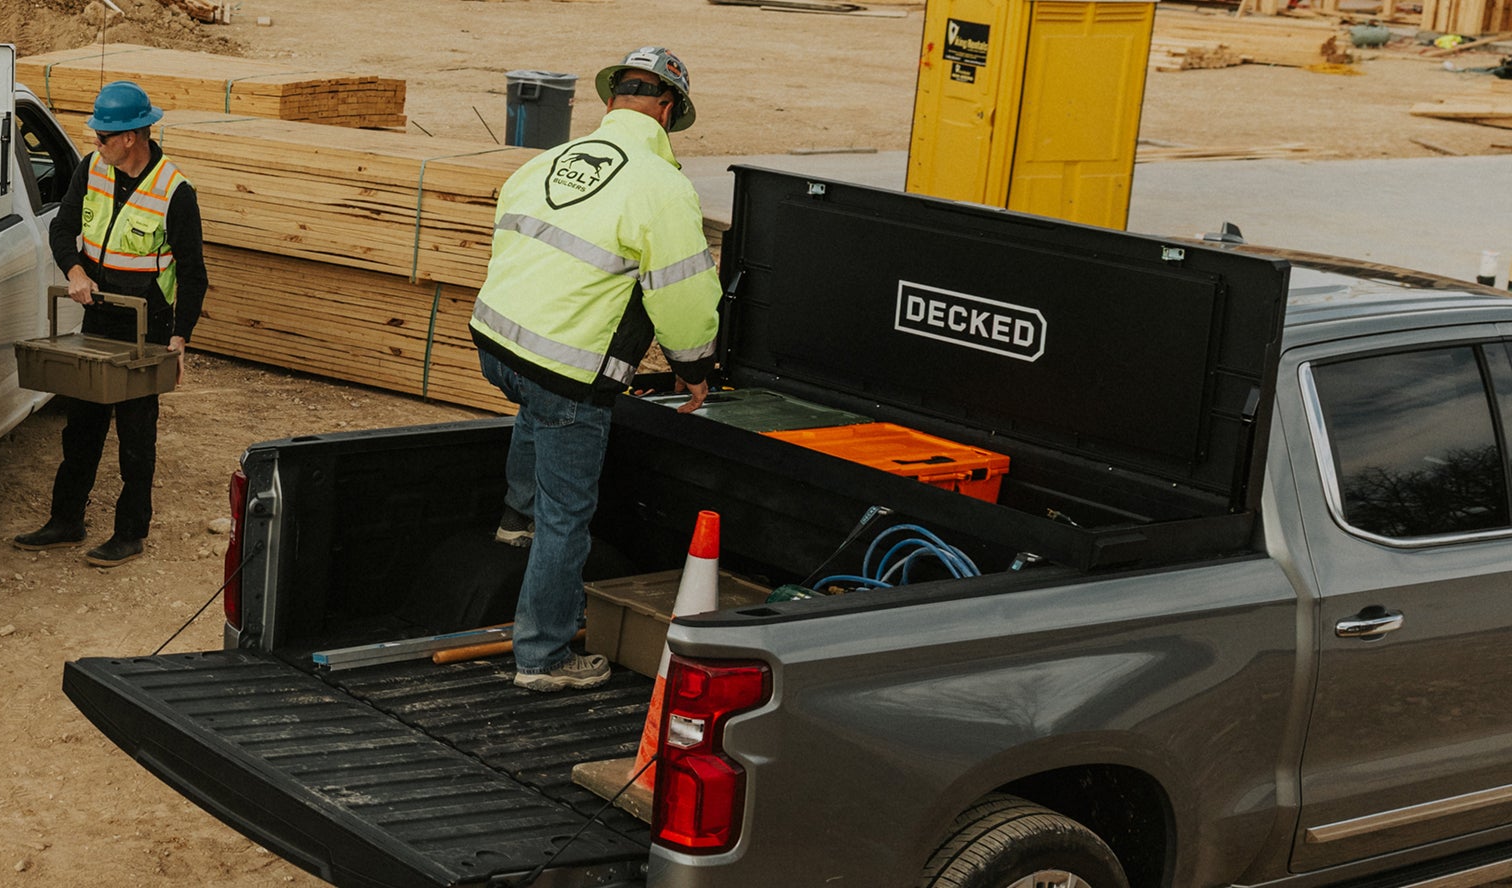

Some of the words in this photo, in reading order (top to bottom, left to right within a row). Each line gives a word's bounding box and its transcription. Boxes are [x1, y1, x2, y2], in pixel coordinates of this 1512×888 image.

[553, 178, 586, 192] BUILDERS
[557, 168, 600, 186] COLT
[906, 295, 1035, 348] DECKED
